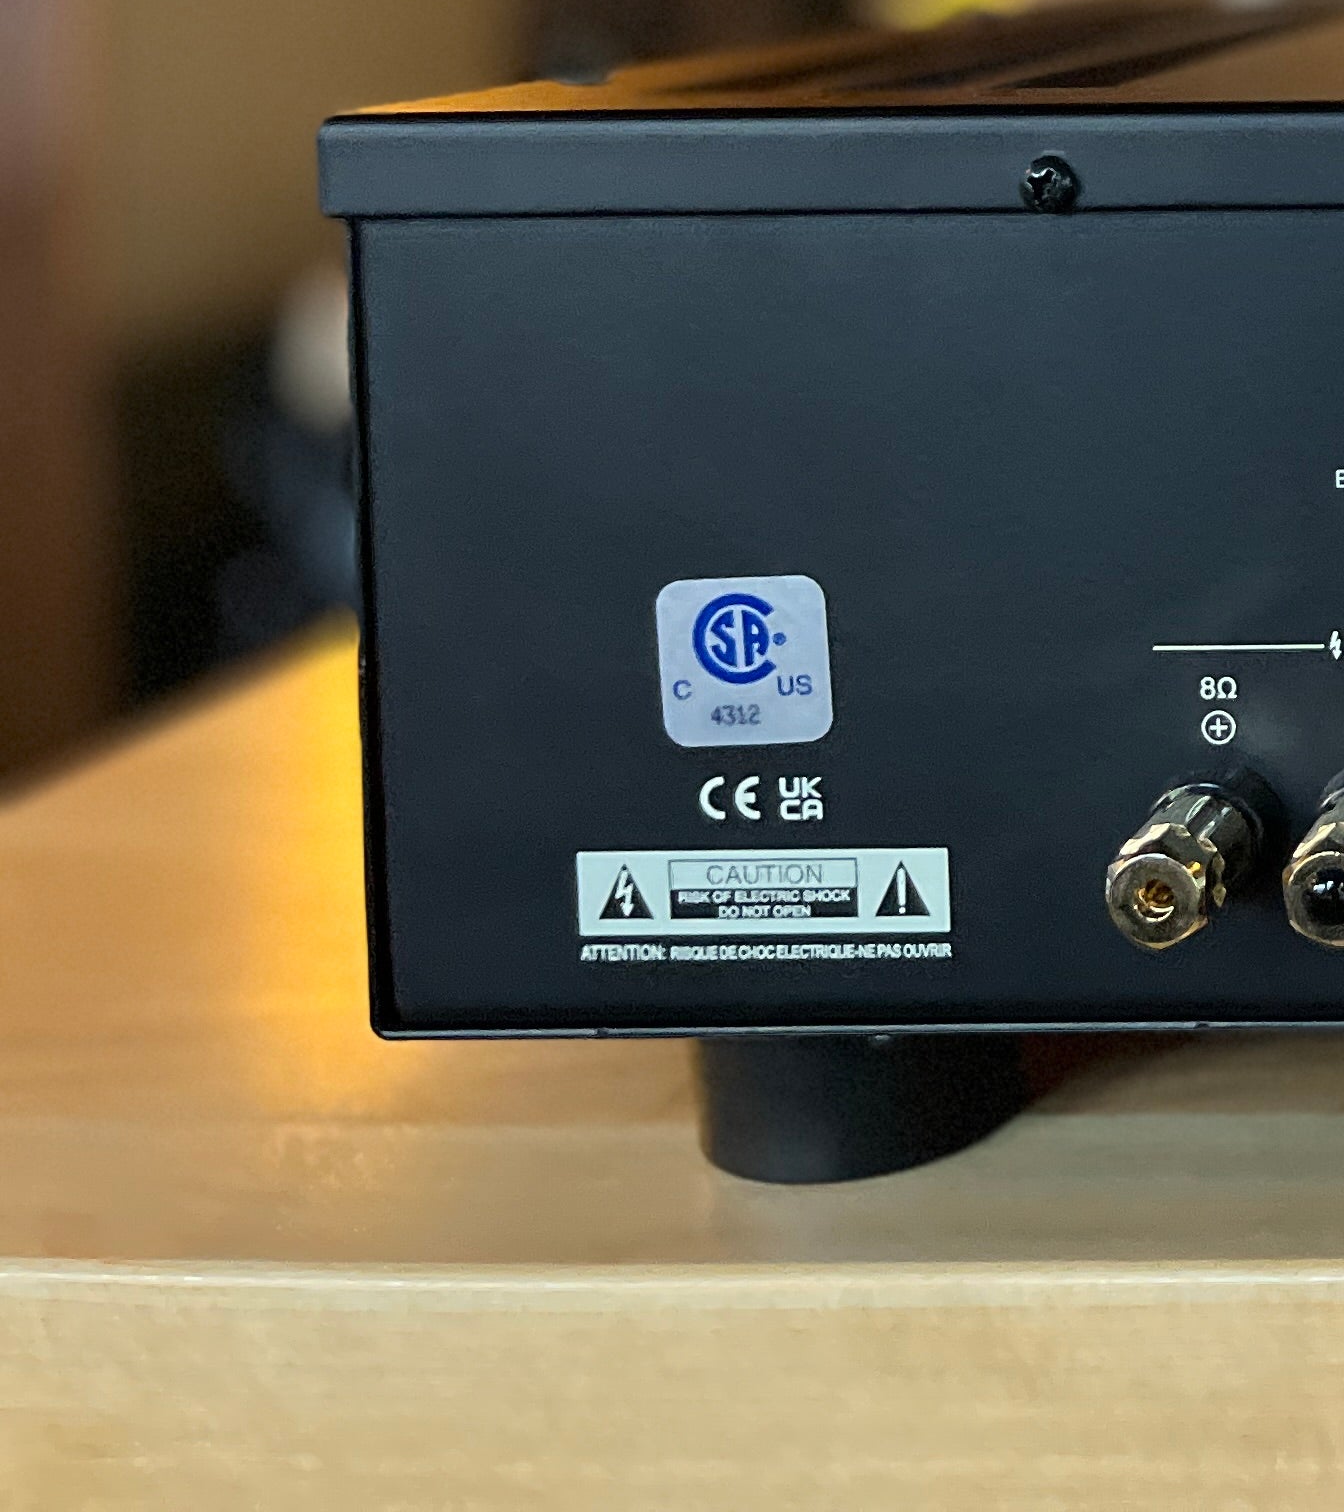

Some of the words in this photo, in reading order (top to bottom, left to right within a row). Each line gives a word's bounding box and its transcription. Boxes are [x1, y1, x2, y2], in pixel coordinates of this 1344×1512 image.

[777, 675, 812, 696] US
[1200, 677, 1237, 701] 8Ω
[706, 864, 823, 885] CAUTION
[711, 891, 731, 902] OF
[718, 905, 740, 918] DO
[742, 905, 771, 918] NOT
